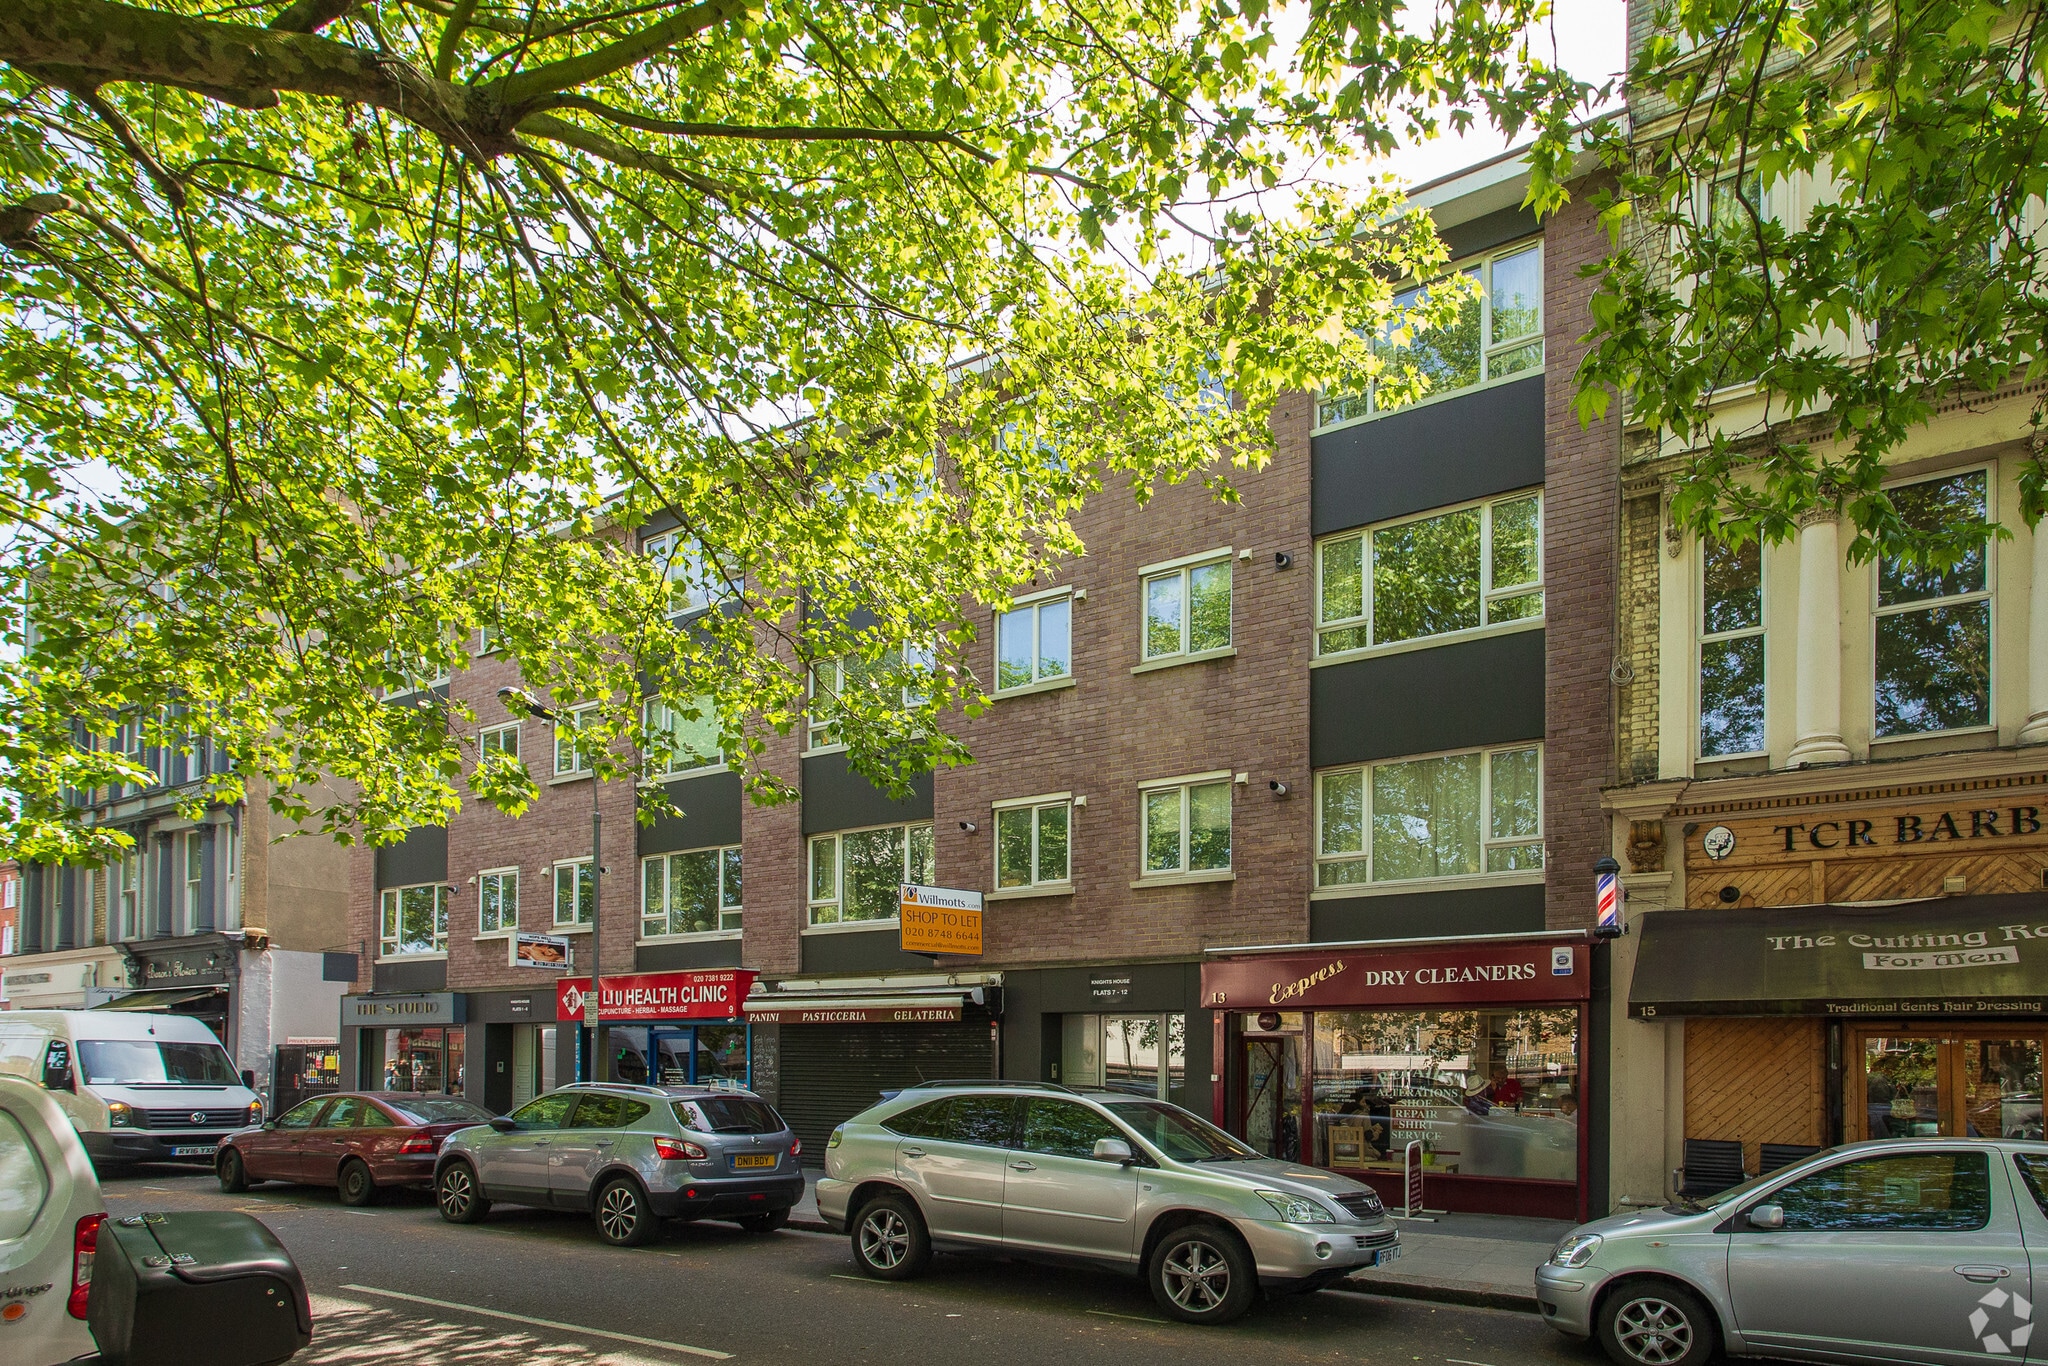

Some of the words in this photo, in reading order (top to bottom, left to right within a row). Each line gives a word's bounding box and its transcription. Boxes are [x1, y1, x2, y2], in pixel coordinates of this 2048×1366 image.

[1773, 819, 1877, 851] TCR
[1894, 806, 2041, 843] BARB
[918, 894, 966, 908] Willmotts
[906, 910, 938, 924] SHOP
[941, 913, 958, 926] TO
[960, 916, 978, 928] LET
[906, 926, 924, 936] 020
[928, 929, 952, 939] 8748
[956, 931, 979, 941] 6644
[1766, 935, 1836, 950] The
[1848, 931, 1988, 948] Cutting
[1873, 955, 1924, 967] For
[1933, 952, 2008, 966] Men
[1365, 970, 1410, 986] DRY
[1414, 963, 1536, 984] CLEANERS
[1269, 959, 1348, 1004] Express
[626, 987, 677, 1005] HEALTH
[681, 985, 727, 1003] CLINIC
[1212, 992, 1226, 1004] 13
[356, 1004, 383, 1015] THE
[384, 1002, 438, 1014] STUDIO
[729, 1005, 734, 1013] 9
[1640, 1006, 1656, 1016] 15
[1826, 1003, 1897, 1012] Traditional
[1901, 1002, 1939, 1012] Gents
[1944, 1002, 1972, 1012] Hair
[1976, 1000, 2041, 1012] Dressing
[749, 1013, 780, 1022] PANINI
[802, 1012, 866, 1022] PASTICCERIA
[893, 1010, 954, 1020] GELATERIA
[1377, 1089, 1458, 1097] ALTERATIONS
[1396, 1110, 1438, 1118] REPAIR
[1399, 1120, 1433, 1129] SHIRT
[1392, 1131, 1442, 1140] SERVICE
